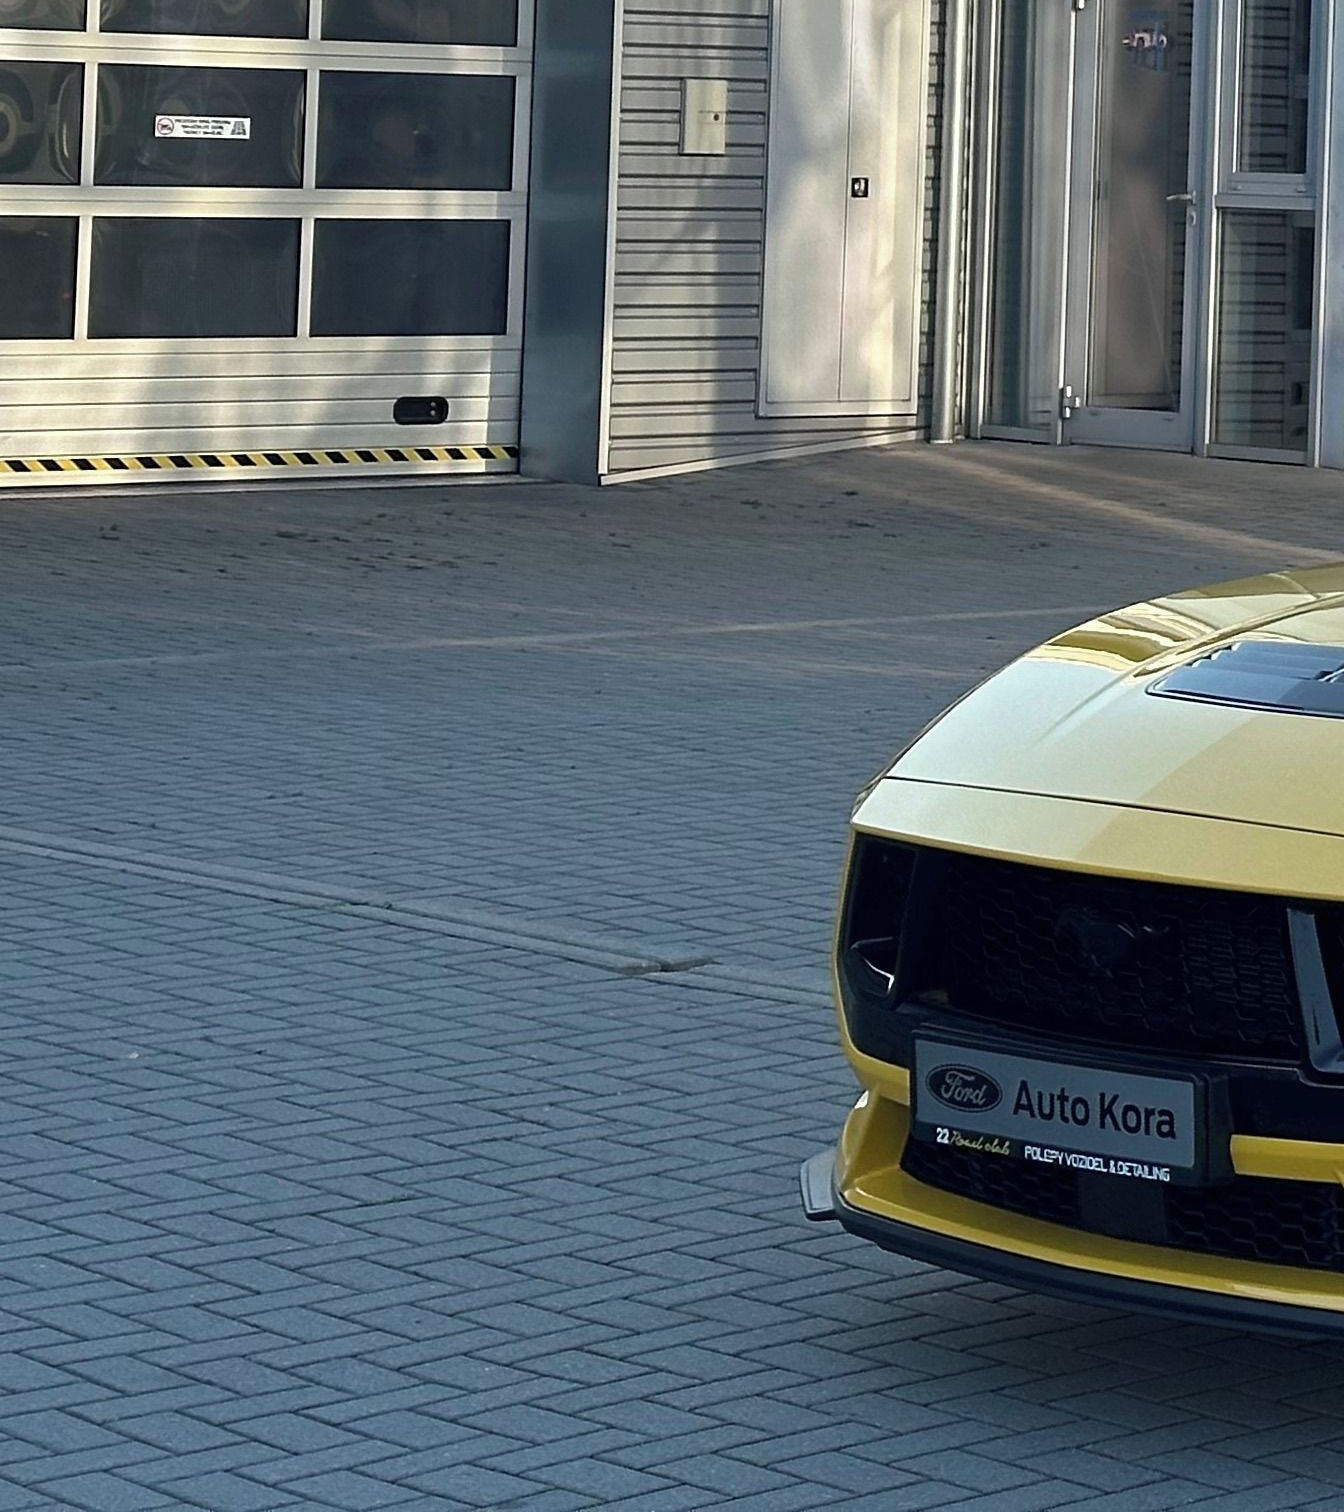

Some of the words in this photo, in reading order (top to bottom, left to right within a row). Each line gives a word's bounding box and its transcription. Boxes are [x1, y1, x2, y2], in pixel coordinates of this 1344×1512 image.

[940, 1070, 986, 1106] Ford
[1012, 1079, 1090, 1124] Auto
[1099, 1092, 1177, 1140] Kora
[1116, 1161, 1170, 1182] DETAILING
